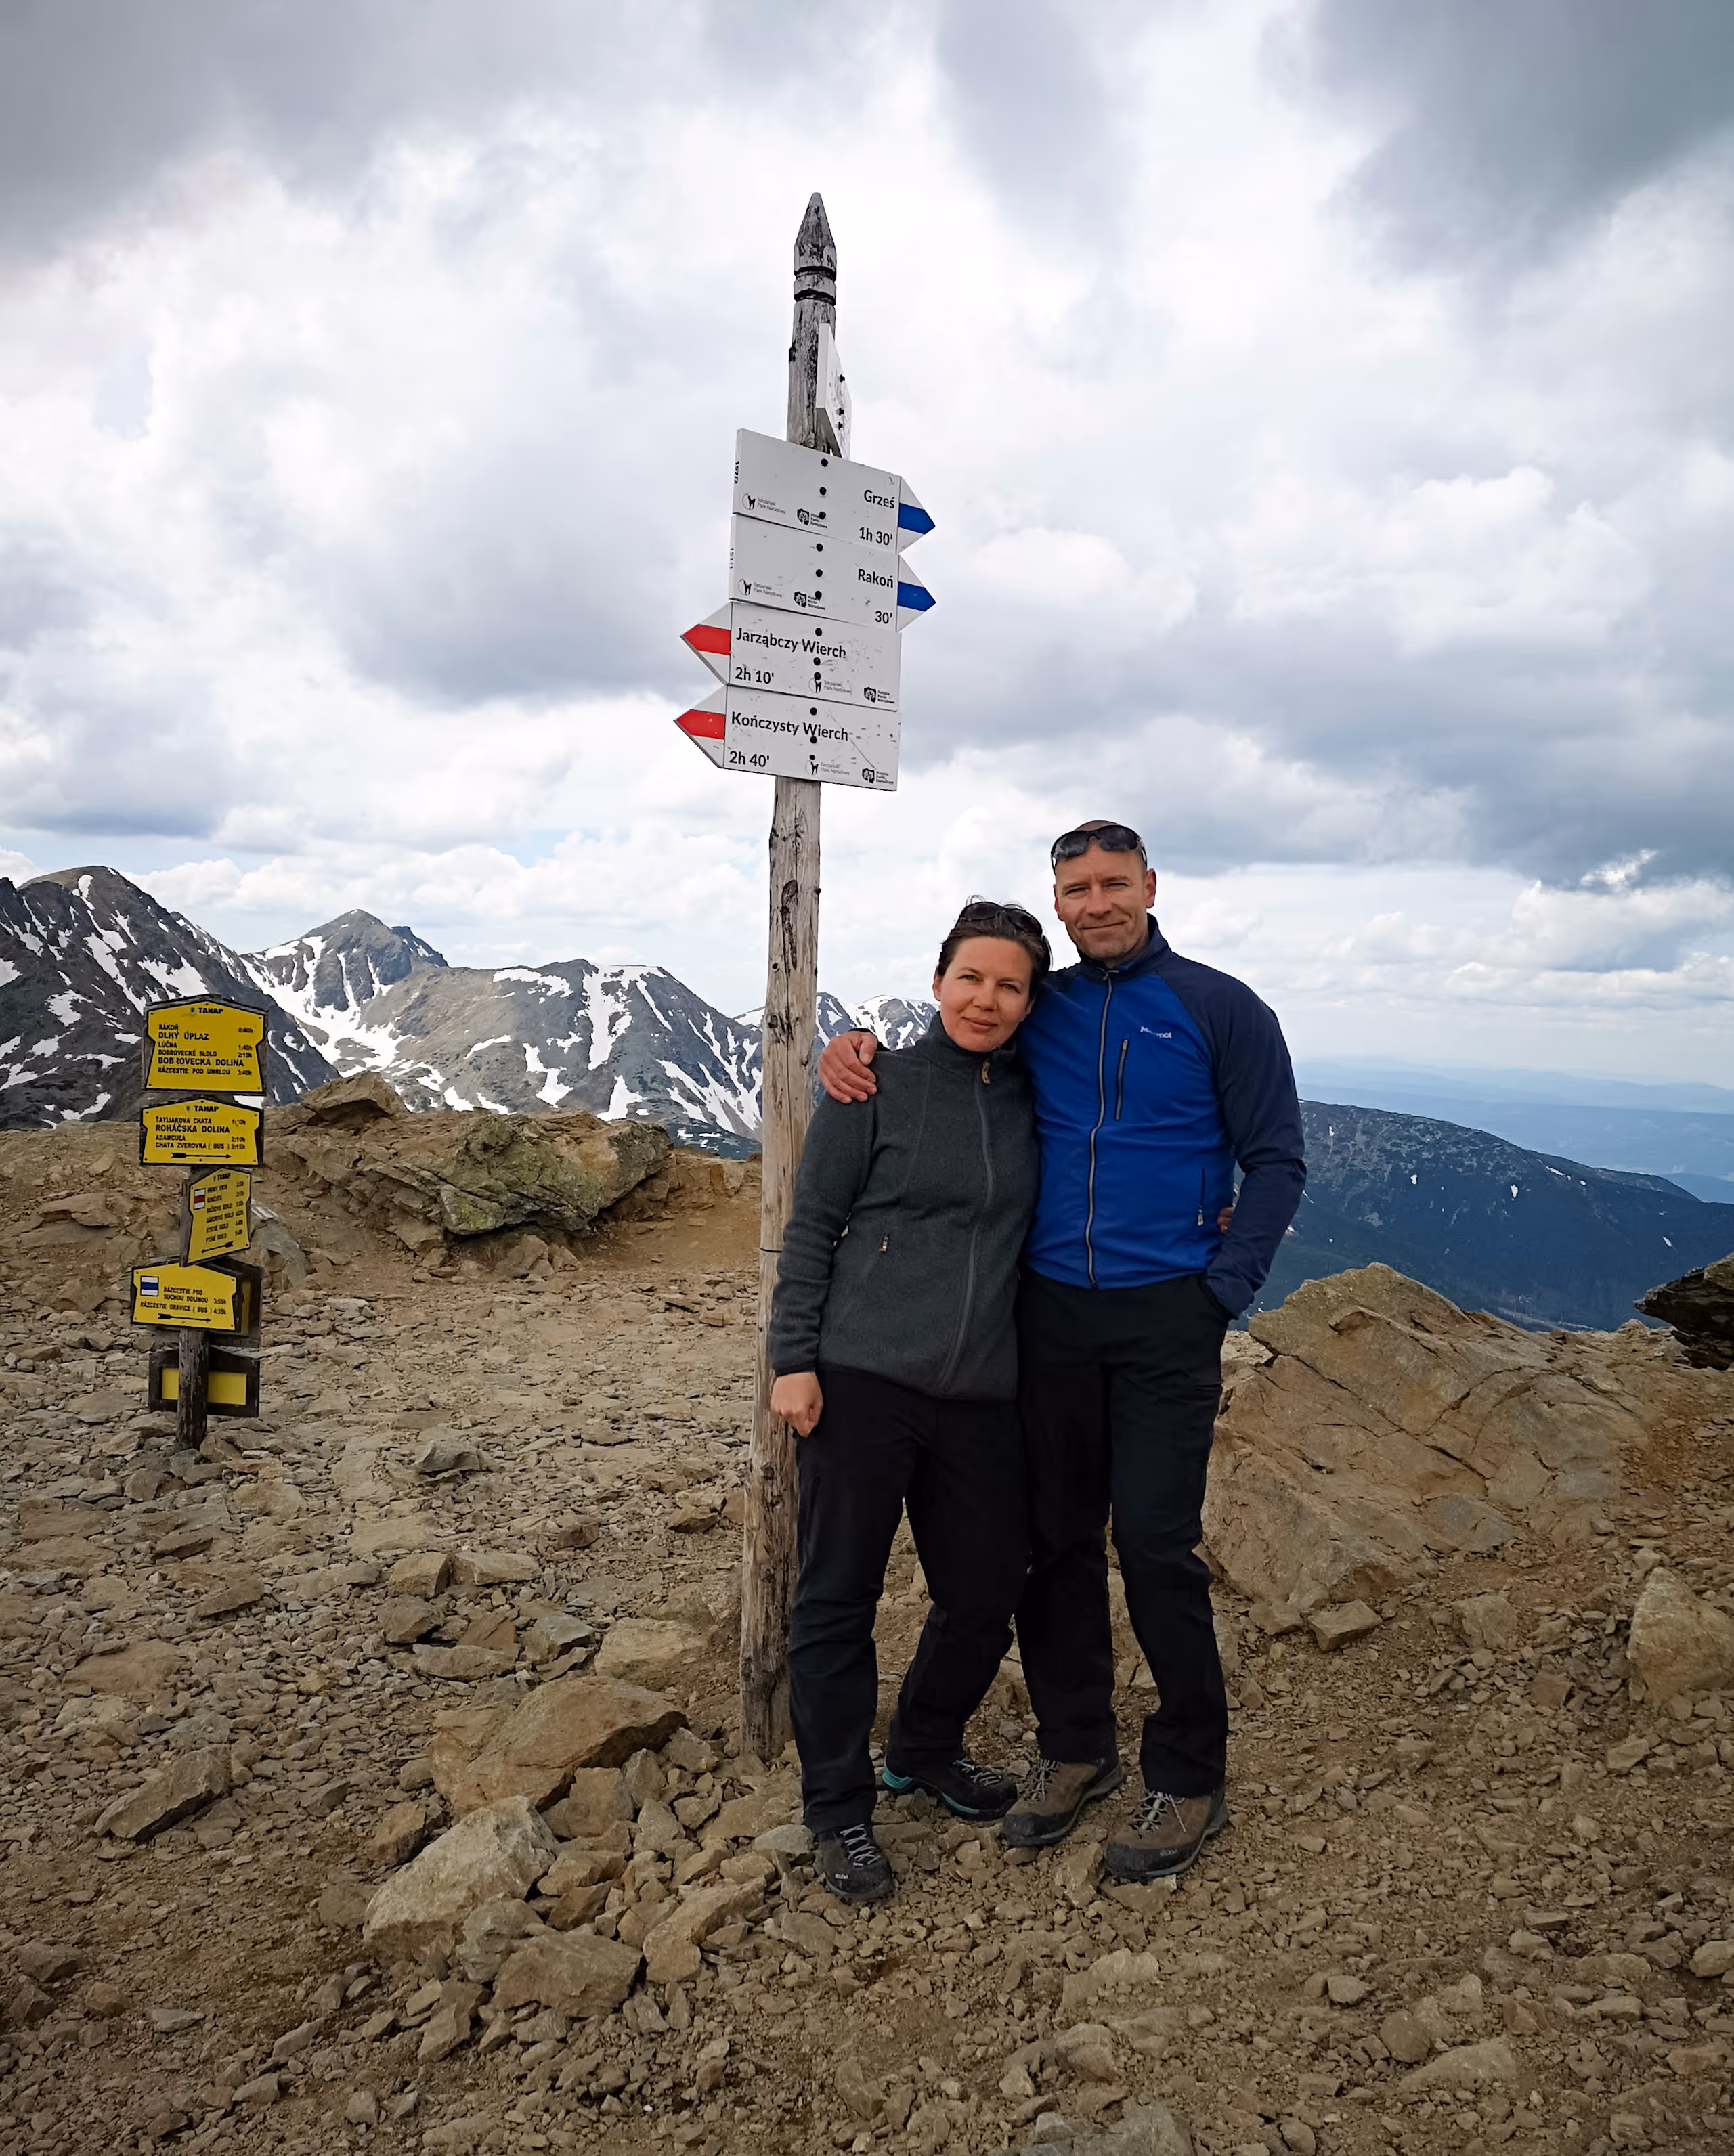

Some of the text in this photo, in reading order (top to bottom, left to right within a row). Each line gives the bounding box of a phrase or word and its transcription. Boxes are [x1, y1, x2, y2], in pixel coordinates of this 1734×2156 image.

[864, 489, 895, 509] Grześ
[859, 527, 893, 546] 1h 30'
[858, 569, 894, 588] Rakoń
[875, 611, 892, 624] 30'
[736, 628, 846, 658] Jarząbczy Wierch
[735, 667, 774, 684] 2h 10'
[731, 711, 848, 741] Kończysty Wierch
[729, 751, 770, 768] 2h 40'
[158, 1030, 209, 1040] DLHÝ ÚPLAZ
[158, 1066, 188, 1074] RÁZCESTIE
[215, 1059, 244, 1067] DOLINA
[156, 1124, 198, 1132] ROHÁČSKA
